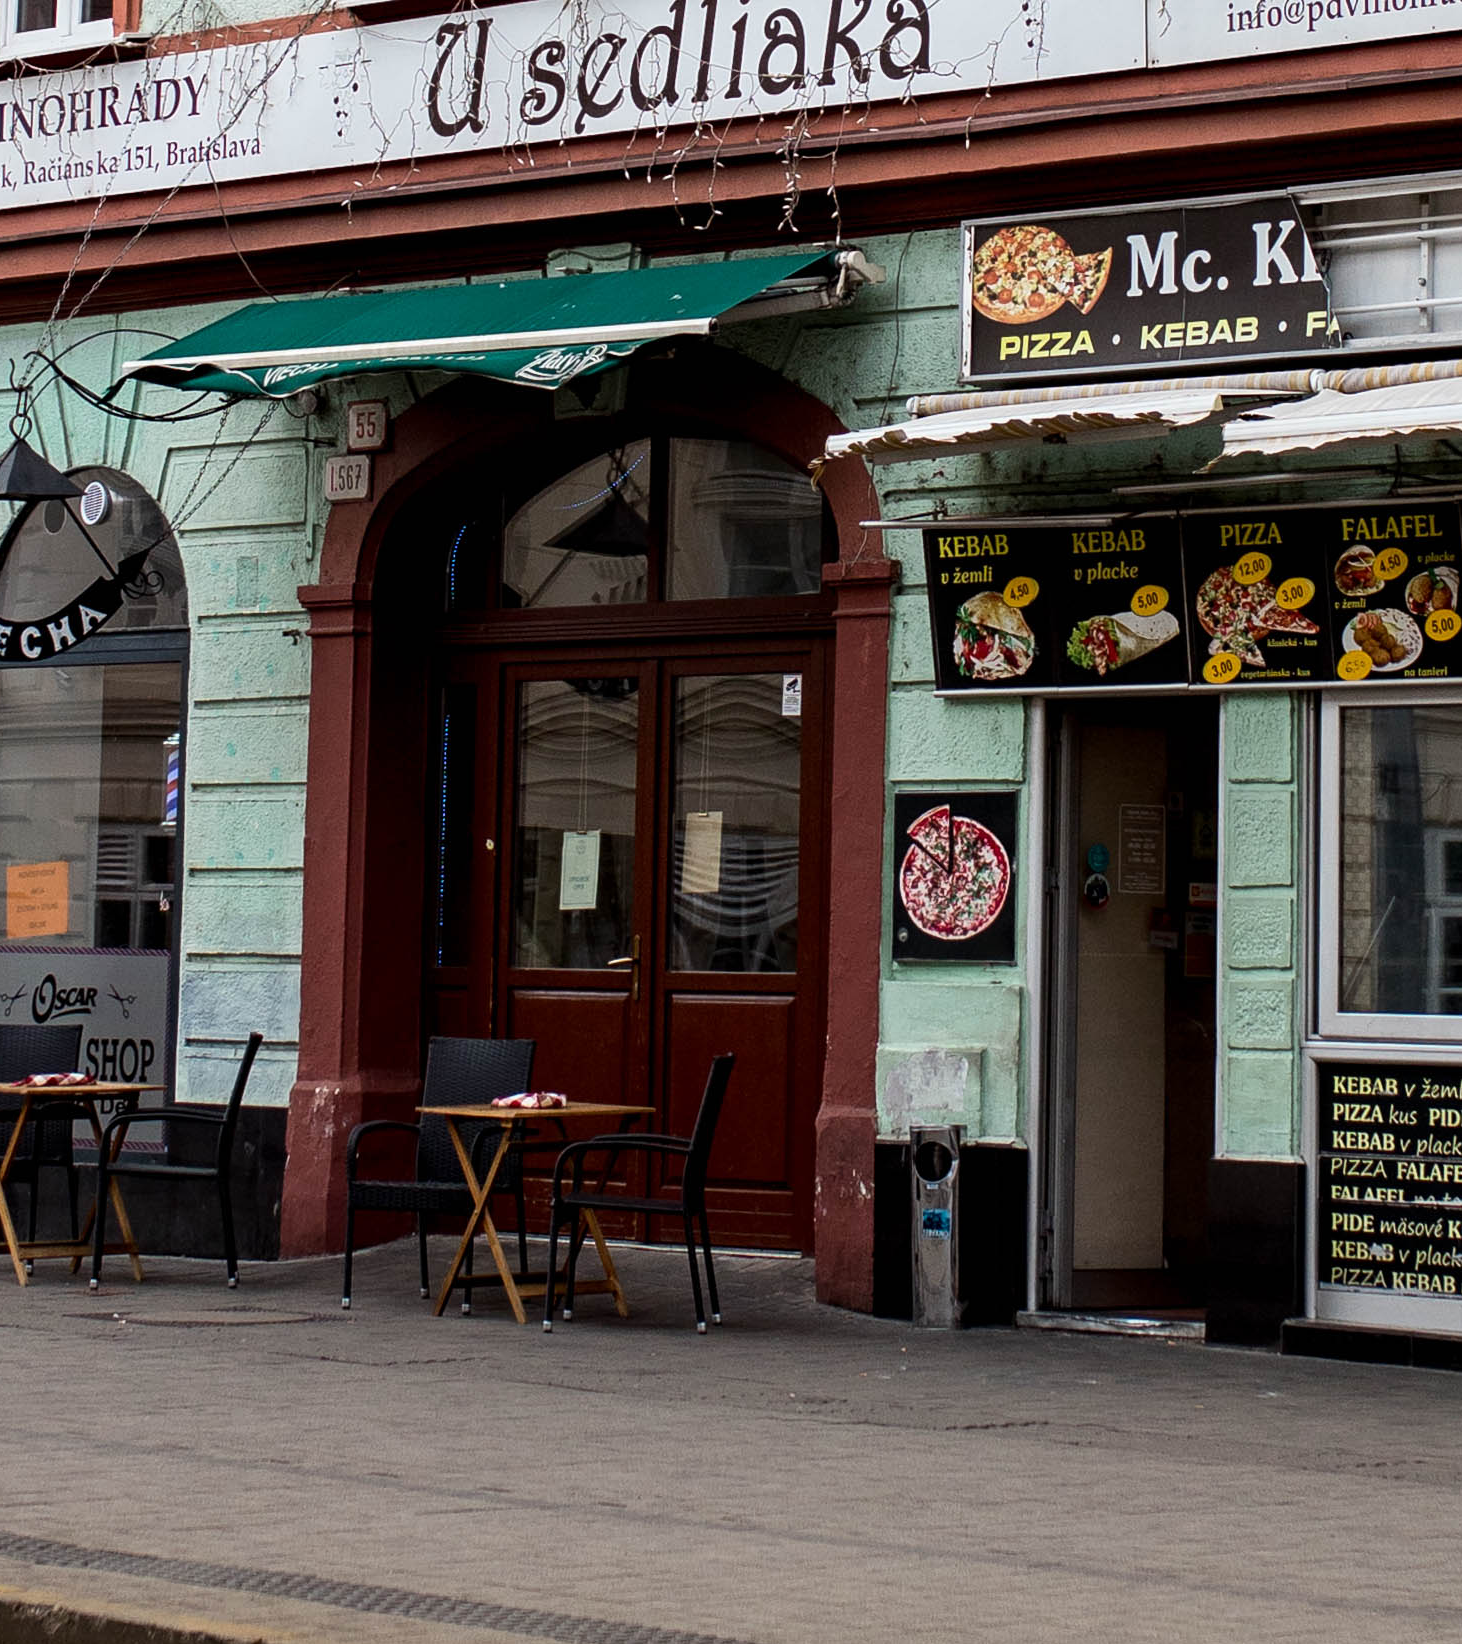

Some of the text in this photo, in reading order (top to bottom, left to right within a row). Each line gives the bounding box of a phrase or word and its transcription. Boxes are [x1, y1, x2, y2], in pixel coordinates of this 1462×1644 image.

[426, 17, 492, 138] U
[125, 146, 159, 174] 151,
[166, 134, 261, 167] Bratislava
[1126, 230, 1230, 298] Mc.
[999, 316, 1259, 362] PIZZA KEBAB
[355, 411, 377, 439] 55
[1219, 521, 1283, 547] PIZZA
[1341, 514, 1443, 541] FALAFEL
[938, 533, 1010, 559] KEBAB
[1071, 529, 1146, 555] KEBAB
[941, 565, 993, 585] v žemli
[1074, 561, 1139, 585] v placke
[1238, 558, 1265, 577] 12,00
[1379, 554, 1401, 573] 4,50
[1009, 583, 1029, 601] 4,50
[1137, 591, 1159, 609] 5,00
[1281, 584, 1304, 603] 3,00
[1431, 616, 1454, 634] 5,00
[1211, 659, 1234, 678] 3,00
[1403, 665, 1448, 677] na tanieri
[86, 1038, 155, 1084] SHOP
[1333, 1075, 1399, 1096] KEBAB
[1404, 1083, 1416, 1098] v
[1332, 1102, 1384, 1124] PIZZA
[1388, 1104, 1418, 1126] kus
[1332, 1130, 1396, 1152] KEBAB
[1400, 1138, 1411, 1153] v
[1330, 1157, 1388, 1179] PIZZA
[1331, 1212, 1375, 1233] PIDE
[1380, 1217, 1444, 1238] mäsové
[1399, 1249, 1411, 1264] v
[1331, 1266, 1388, 1288] PIZZA
[1392, 1271, 1457, 1295] KEBAB
